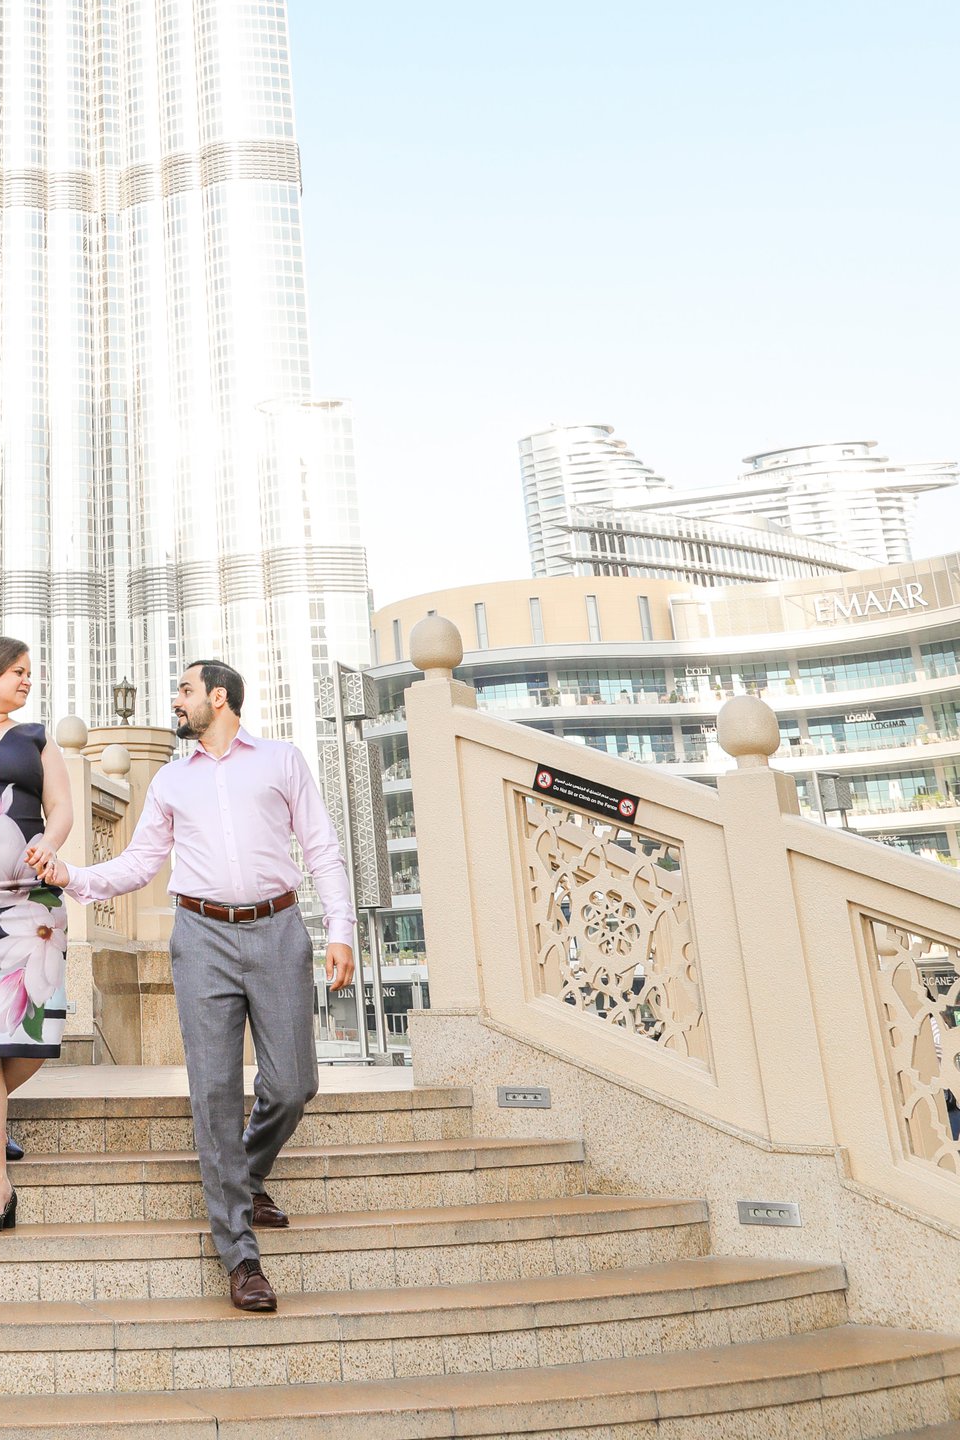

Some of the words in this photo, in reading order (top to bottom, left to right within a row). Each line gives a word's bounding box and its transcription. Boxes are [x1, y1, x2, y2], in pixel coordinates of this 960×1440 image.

[814, 582, 928, 622] EMAAR
[844, 712, 877, 723] LOGMA
[579, 793, 590, 802] Climb
[604, 802, 618, 811] Fence
[337, 988, 354, 999] DIN
